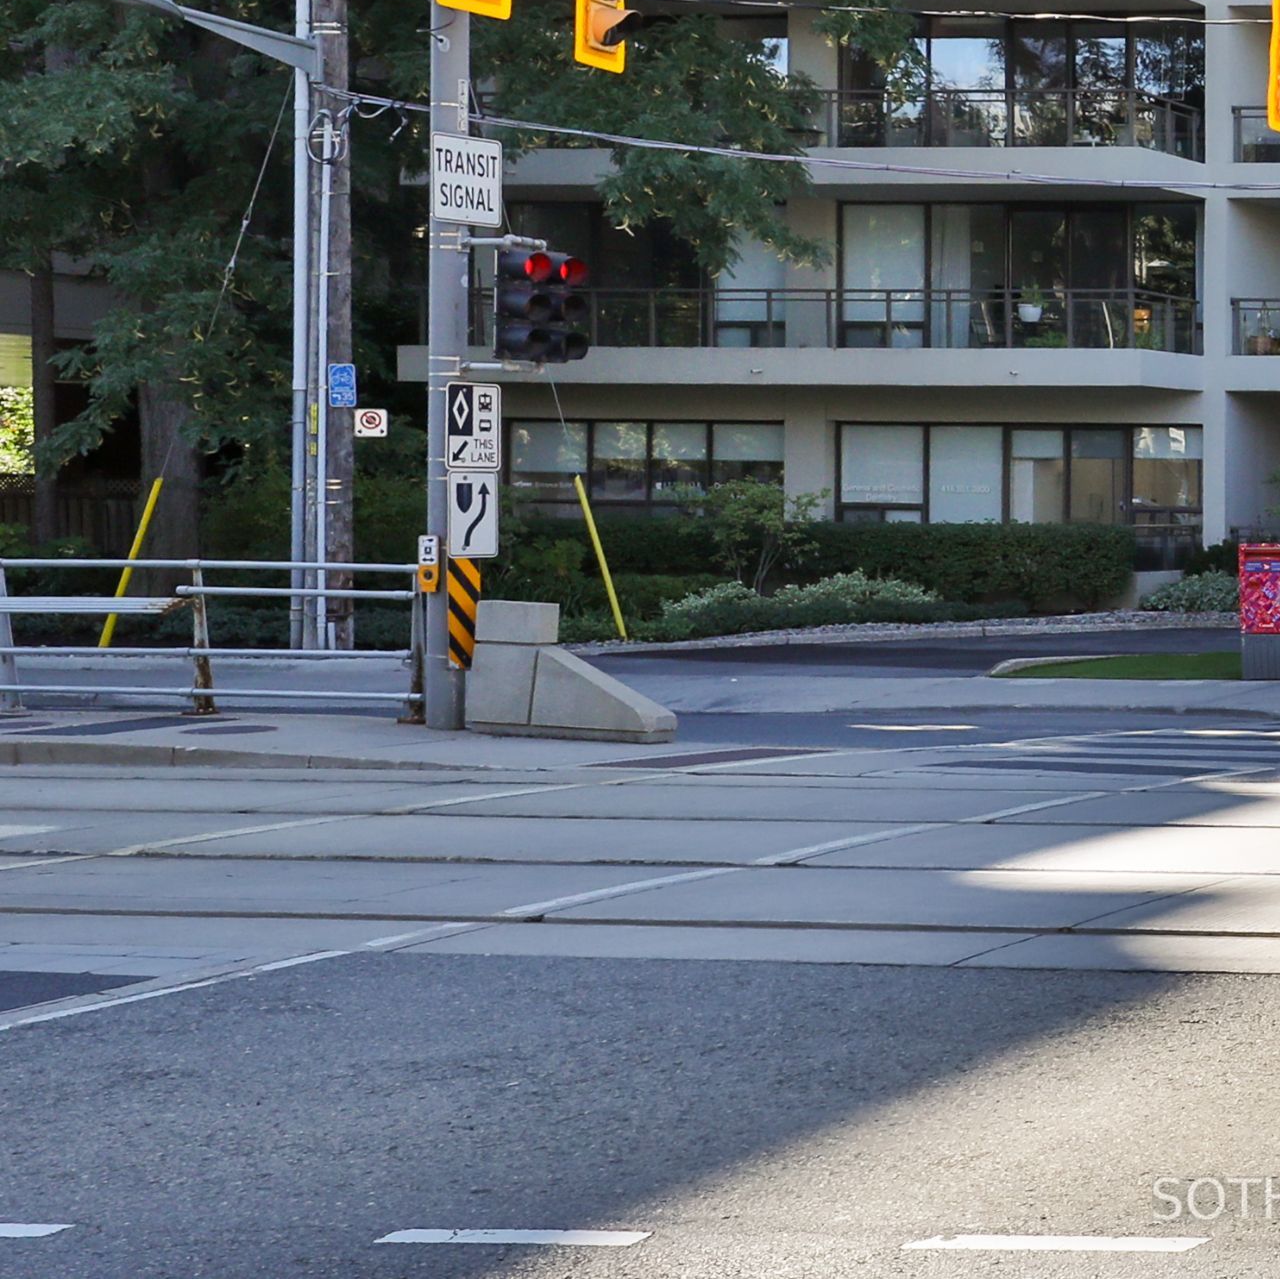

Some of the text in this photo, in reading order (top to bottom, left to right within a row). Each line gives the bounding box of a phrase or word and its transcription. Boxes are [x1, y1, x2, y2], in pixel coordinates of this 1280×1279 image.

[435, 148, 498, 179] TRANSIT
[440, 182, 494, 212] SIGNAL
[473, 438, 494, 450] THIS
[470, 452, 496, 463] LANE
